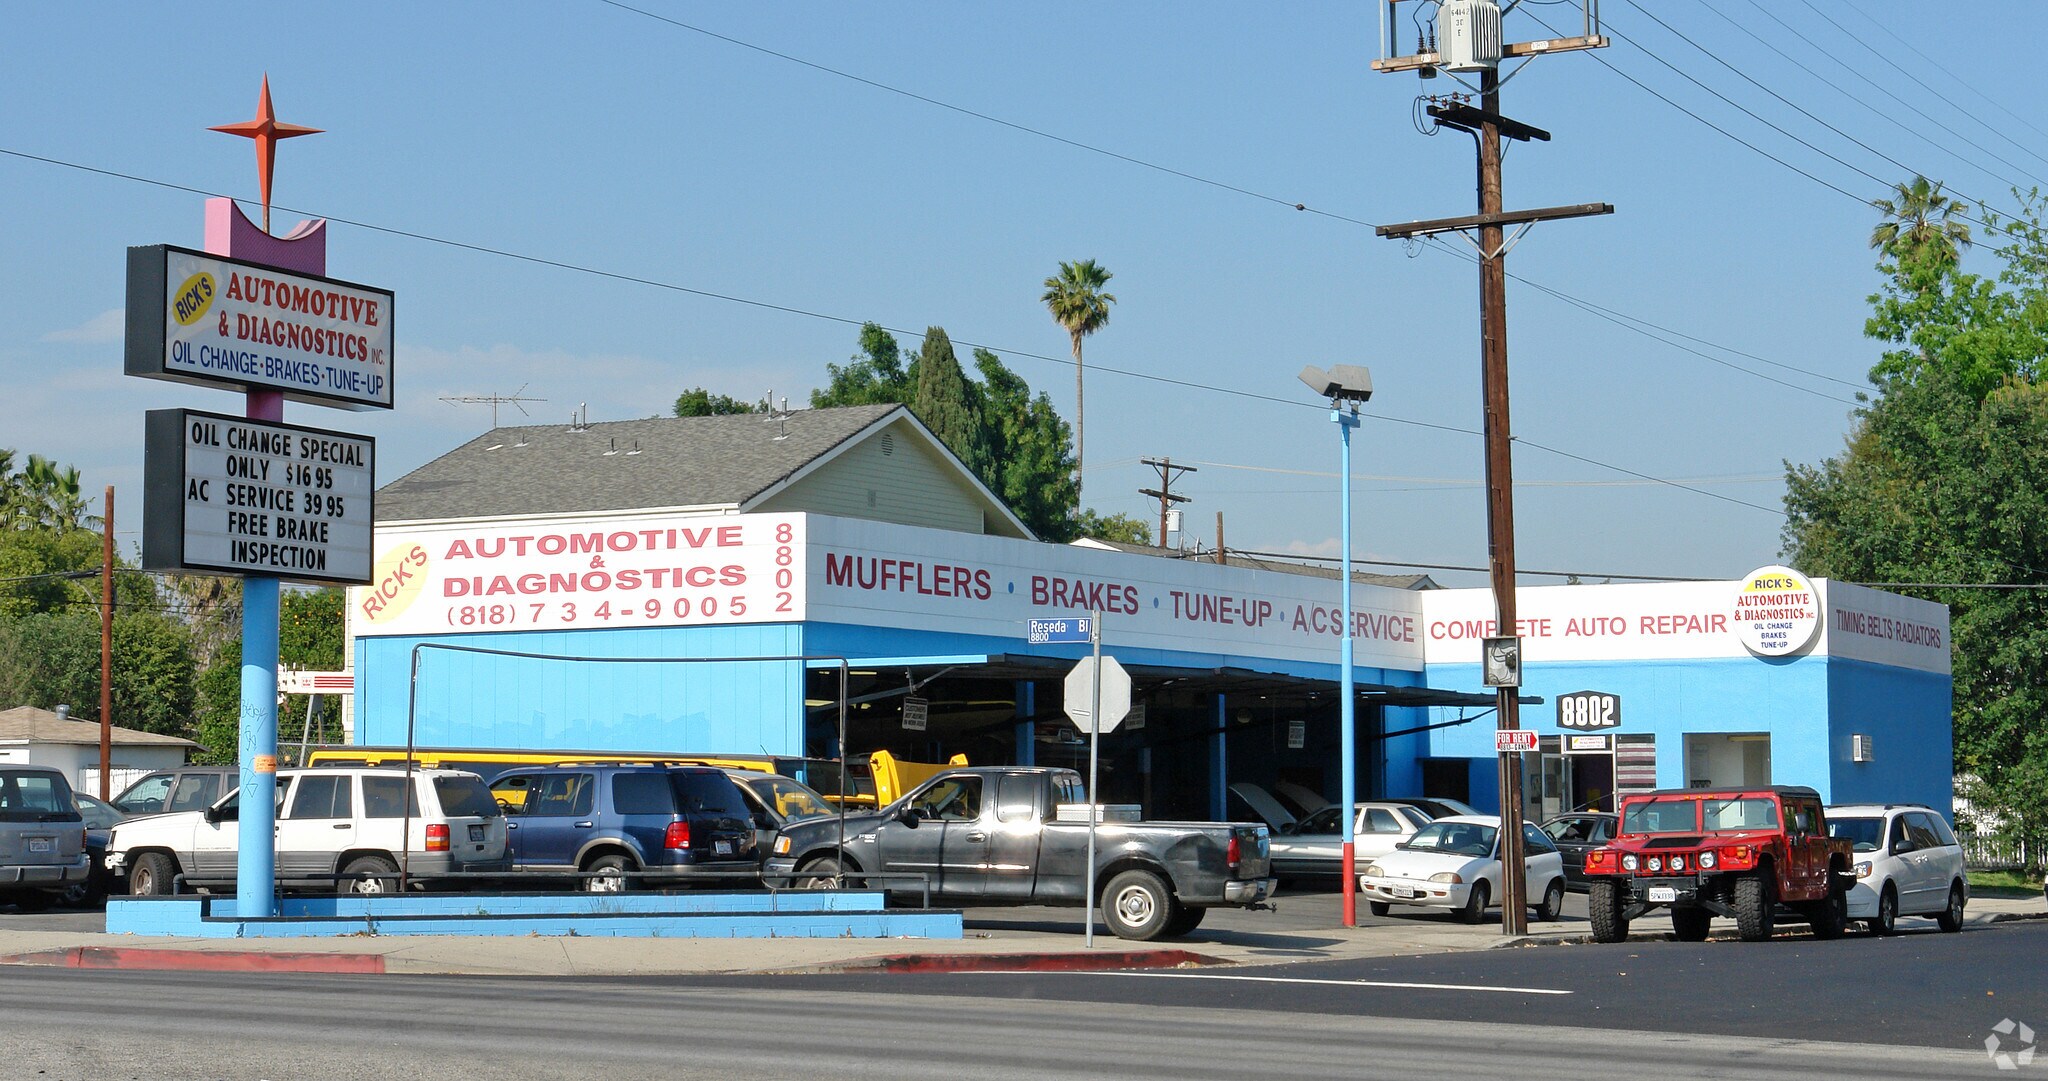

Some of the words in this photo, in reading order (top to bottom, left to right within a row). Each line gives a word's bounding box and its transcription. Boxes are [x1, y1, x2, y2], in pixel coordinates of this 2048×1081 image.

[176, 277, 212, 322] RICK'S
[226, 272, 378, 326] AUTOMOTIVE
[219, 310, 229, 337] &
[237, 313, 367, 361] DIAGNOSTICS
[372, 348, 384, 365] INC.
[172, 340, 195, 364] OIL
[200, 345, 258, 375] CHANGE
[266, 356, 320, 385] BRAKES
[326, 367, 384, 395] TUNE-UP
[192, 422, 220, 446] OIL
[228, 427, 291, 456] CHANGE
[300, 437, 364, 466] SPECIAL
[226, 455, 269, 480] ONLY
[188, 478, 209, 502] AC
[226, 483, 294, 512] SERVICE
[228, 512, 268, 536] FREE
[277, 517, 328, 543] BRAKE
[232, 540, 326, 570] INSPECTION
[444, 526, 743, 560] AUTOMOTIVE
[590, 555, 605, 568] &
[362, 546, 427, 620] RICK'S
[444, 565, 747, 598] DIAGNOSTICS
[826, 553, 992, 600] MUFFLERS
[1032, 576, 1139, 615] BRAKES
[1170, 591, 1272, 627] TUNE-UP
[1755, 578, 1792, 588] RICK'S
[448, 604, 515, 626] (818)
[1734, 610, 1741, 620] &
[1744, 608, 1804, 620] DIAGNOSTICS
[1738, 594, 1809, 606] AUTOMOTIVE
[1030, 633, 1049, 642] 8800
[1031, 620, 1066, 632] Reseda
[1078, 620, 1088, 632] Bl
[1430, 619, 1551, 640] COMPETE
[1565, 616, 1626, 636] AUTO
[1640, 614, 1728, 634] REPAIR
[1836, 609, 1865, 634] TIMING
[1868, 616, 1892, 640] BELTS
[1896, 621, 1940, 649] RADIATORS
[1562, 696, 1614, 726] 8802
[1498, 733, 1510, 743] FOR
[1512, 732, 1530, 744] RENT
